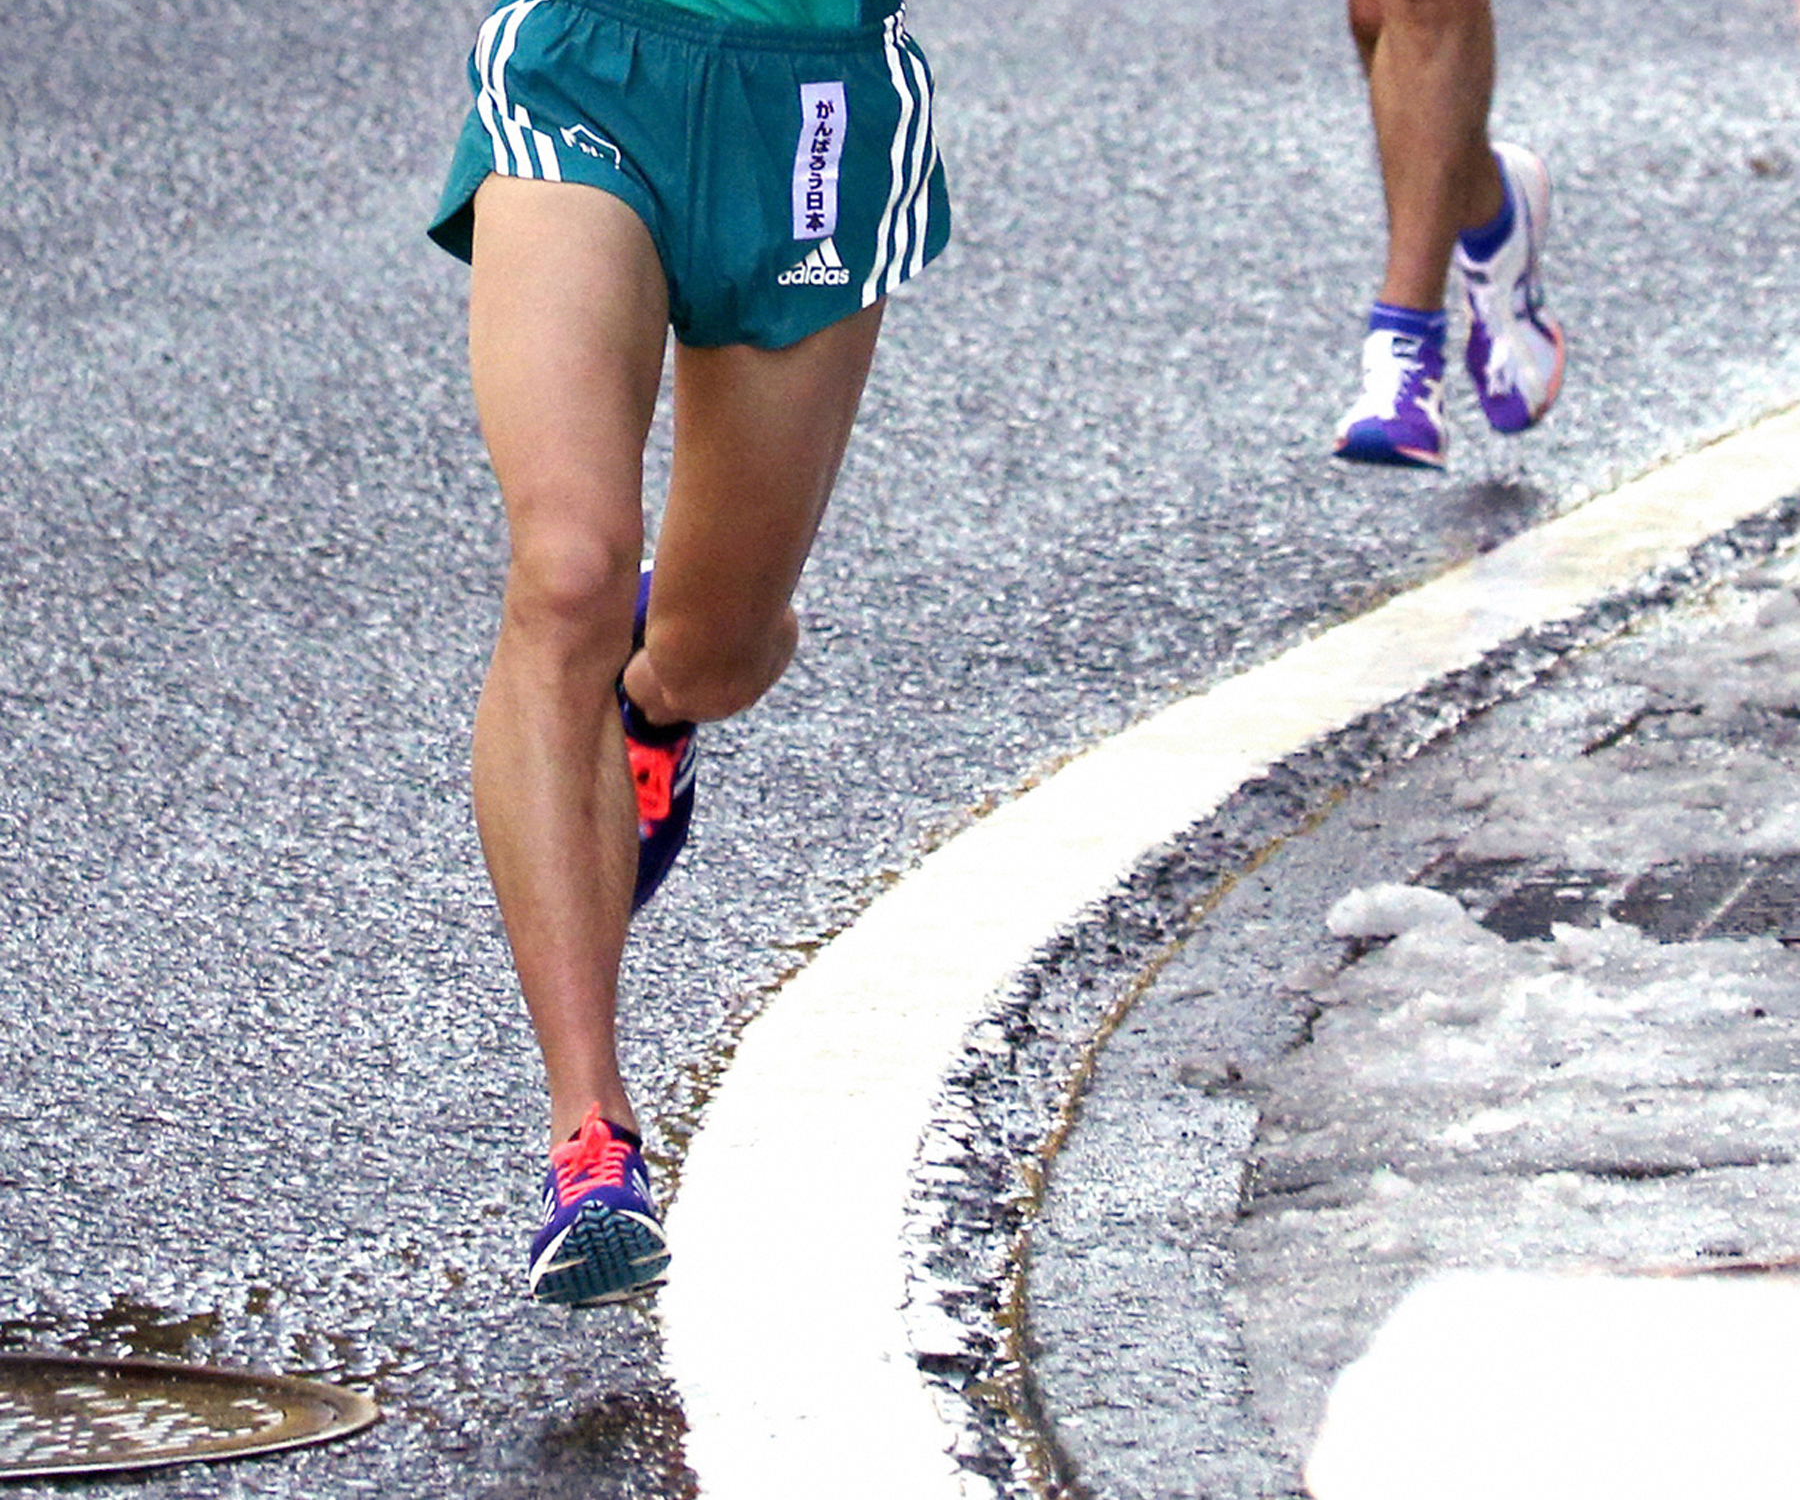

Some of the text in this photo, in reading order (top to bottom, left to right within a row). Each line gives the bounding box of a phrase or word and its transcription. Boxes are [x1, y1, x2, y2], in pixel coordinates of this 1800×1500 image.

[805, 100, 834, 232] がんばろう日本
[778, 266, 849, 285] adidas
